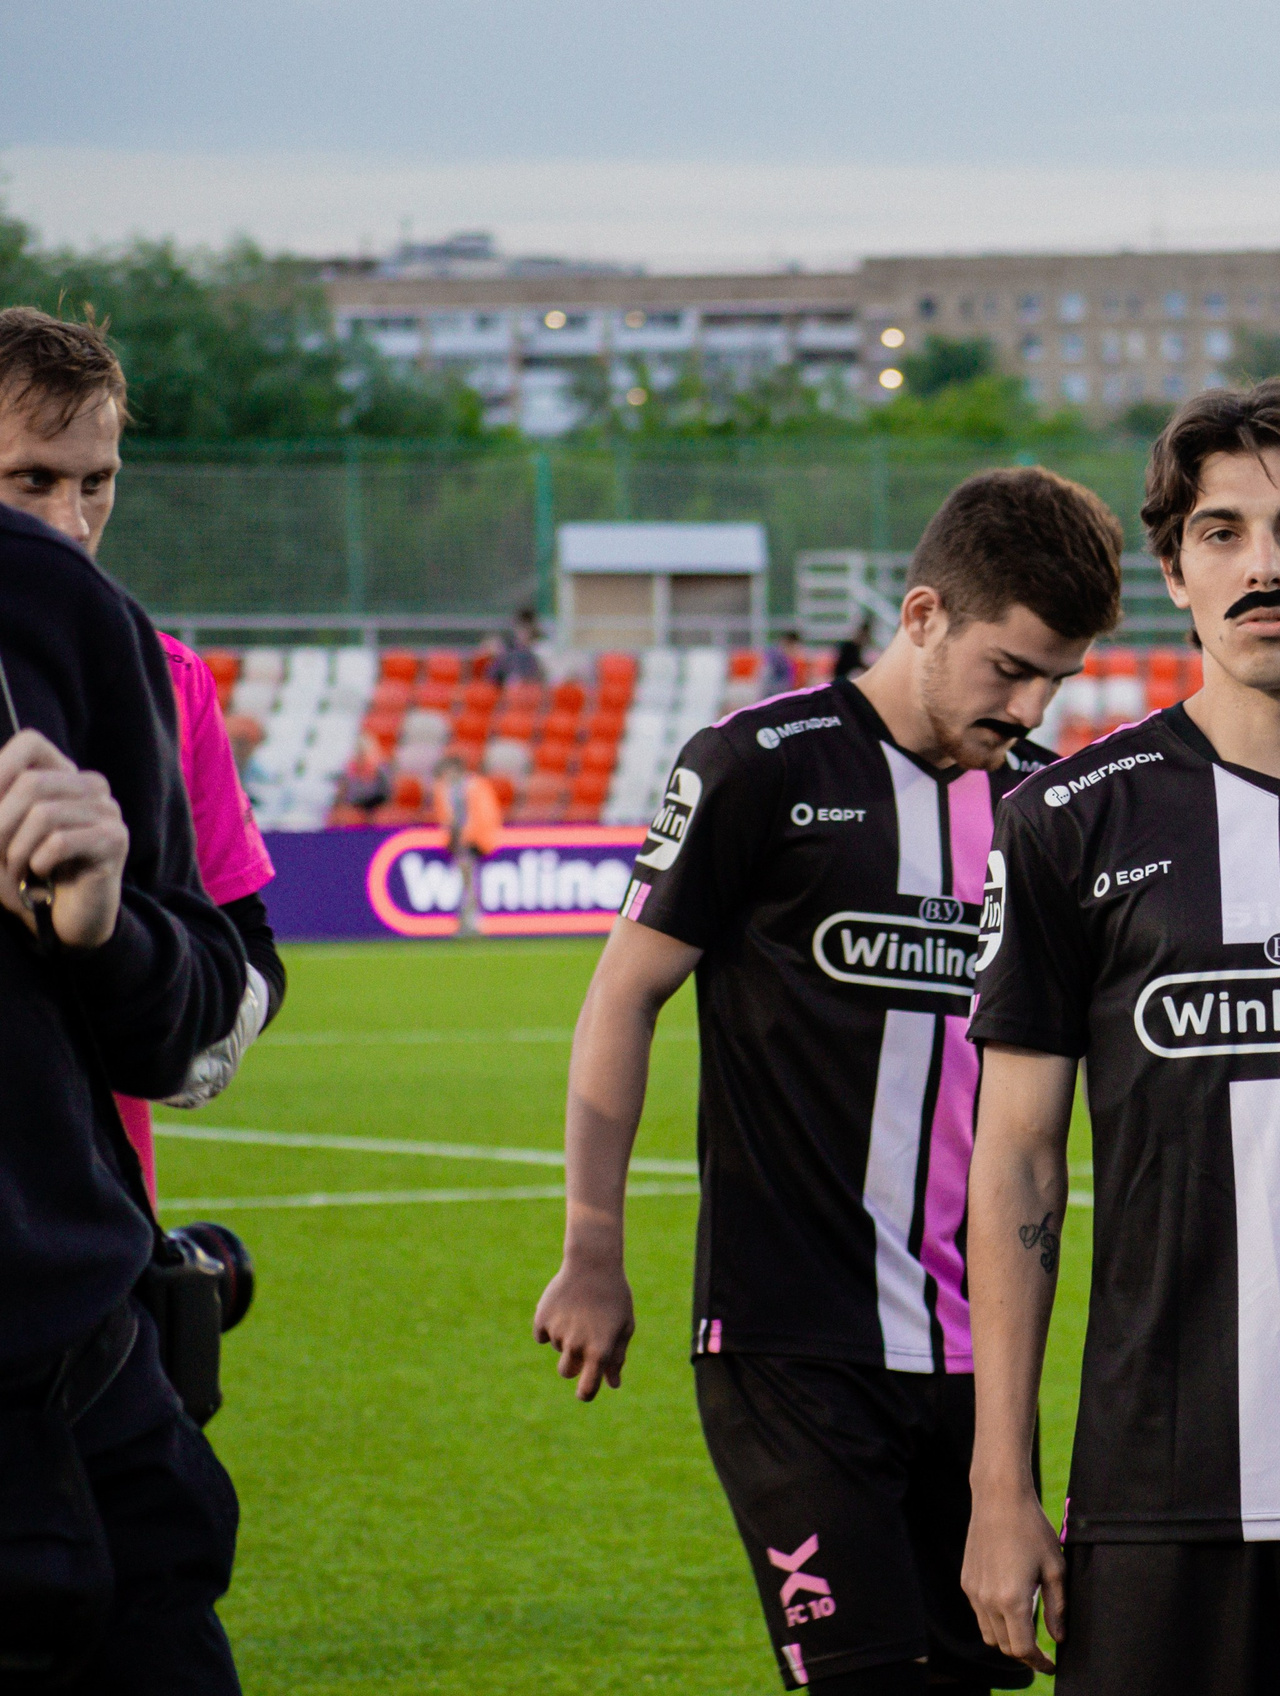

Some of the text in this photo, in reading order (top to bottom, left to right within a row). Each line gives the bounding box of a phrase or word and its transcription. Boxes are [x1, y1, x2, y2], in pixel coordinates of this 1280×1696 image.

[817, 808, 867, 823] EQPT
[401, 851, 632, 912] Wnline
[1116, 860, 1172, 886] EQPT
